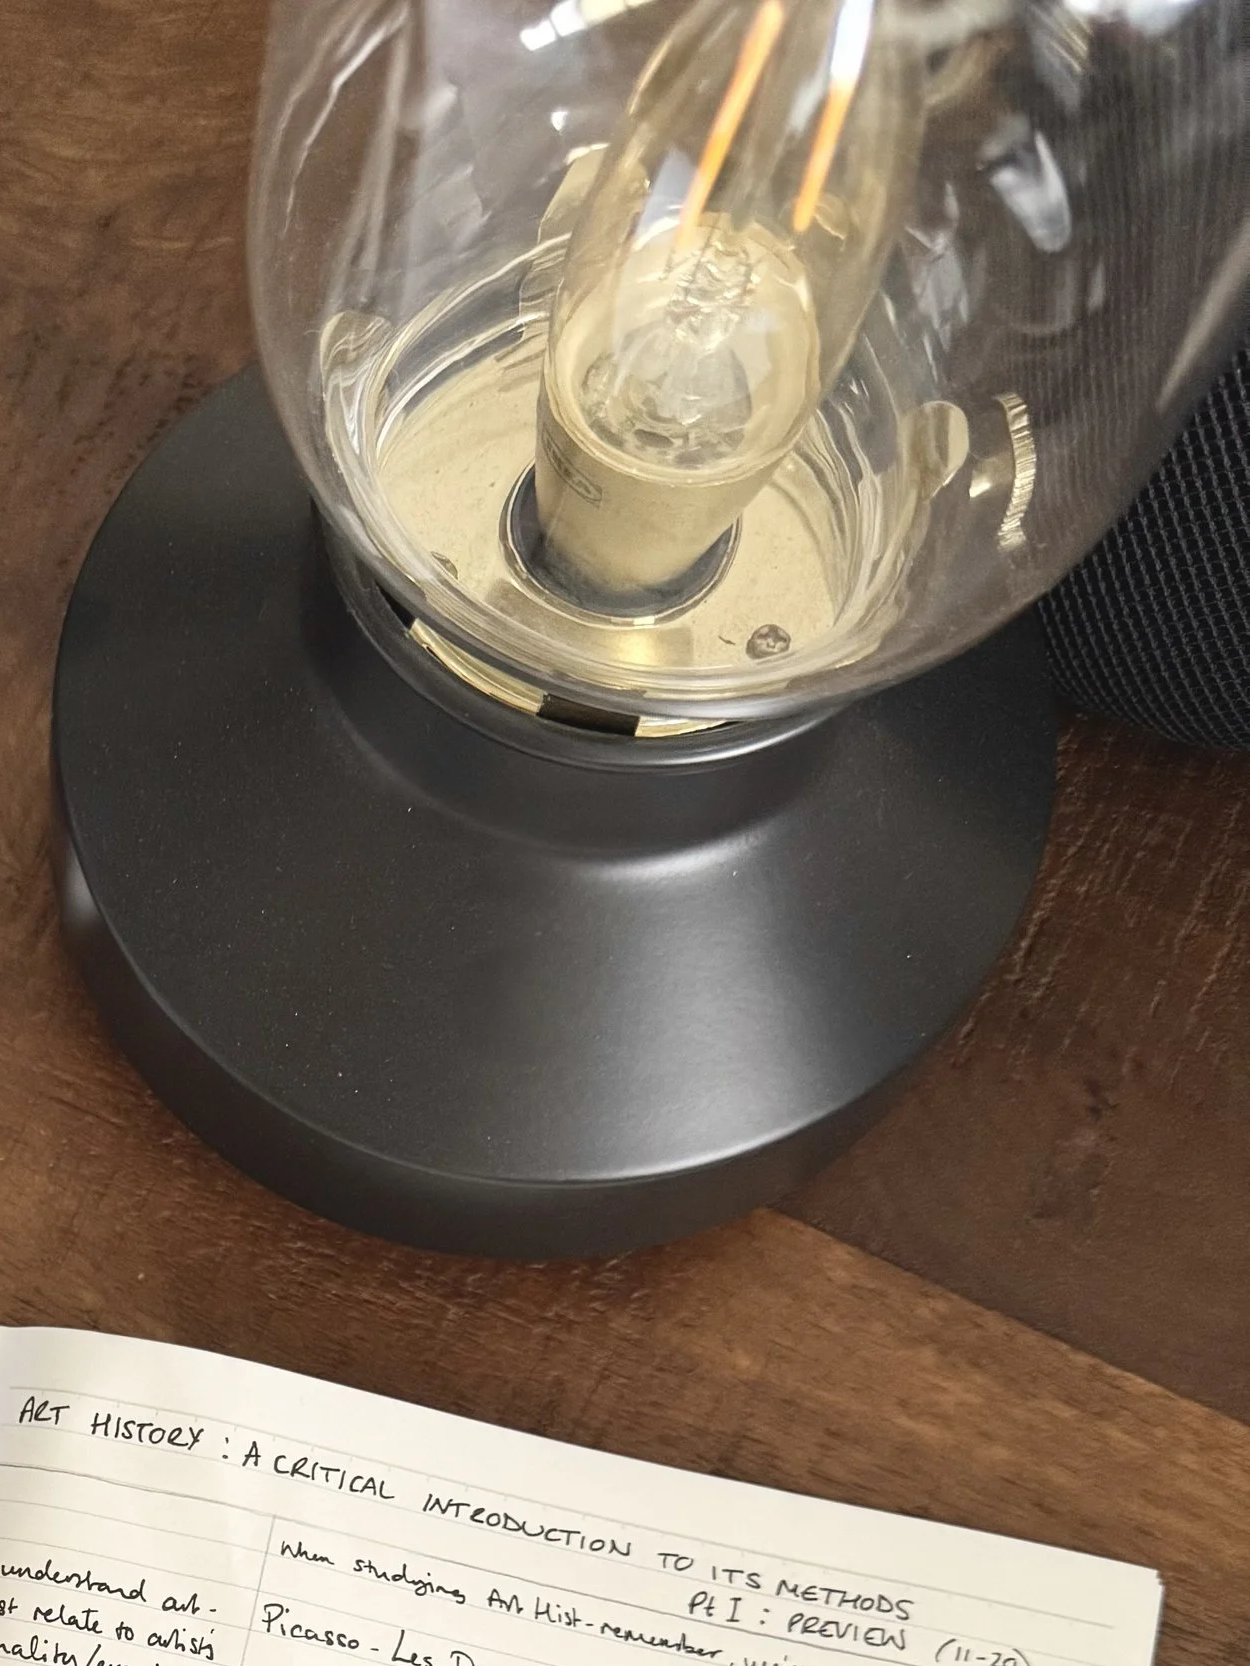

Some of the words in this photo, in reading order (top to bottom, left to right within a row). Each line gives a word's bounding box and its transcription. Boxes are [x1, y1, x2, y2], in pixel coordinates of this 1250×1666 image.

[18, 1395, 71, 1430] ART
[90, 1411, 205, 1456] HISTORY
[241, 1440, 262, 1468] A
[272, 1454, 396, 1500] CRITICAL
[421, 1492, 632, 1557] INTRODUCTION
[656, 1552, 695, 1572] TO
[711, 1565, 762, 1590] ITS
[774, 1578, 915, 1623] METHODS
[280, 1540, 336, 1566] When
[23, 1603, 104, 1639] relate
[260, 1602, 360, 1650] Picasso
[786, 1611, 907, 1652] PREVIEW
